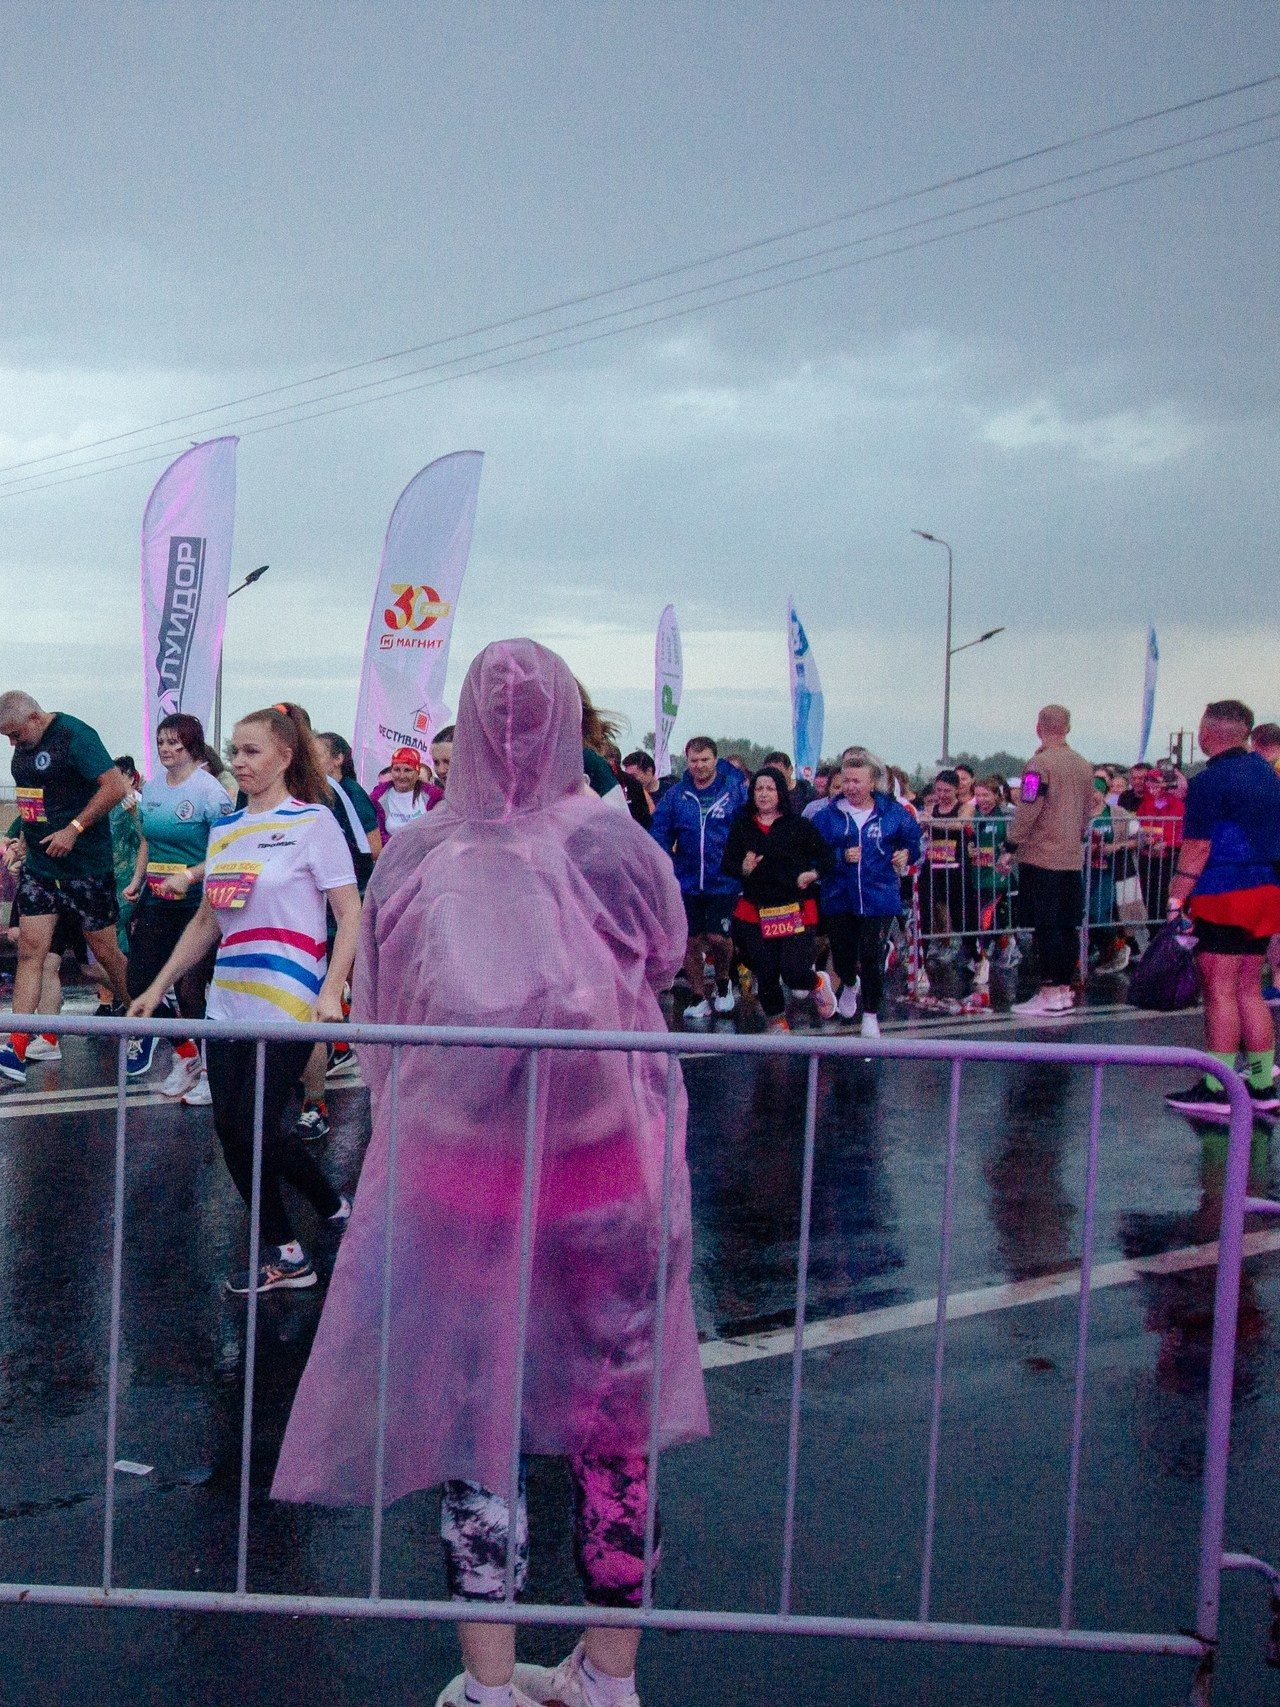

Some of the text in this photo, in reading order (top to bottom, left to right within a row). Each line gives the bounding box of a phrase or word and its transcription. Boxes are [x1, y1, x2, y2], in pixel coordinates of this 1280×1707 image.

[161, 542, 197, 681] ЛУИДОР
[384, 584, 441, 631] 30
[396, 638, 443, 649] МАГНИТ
[763, 922, 794, 936] 2206
